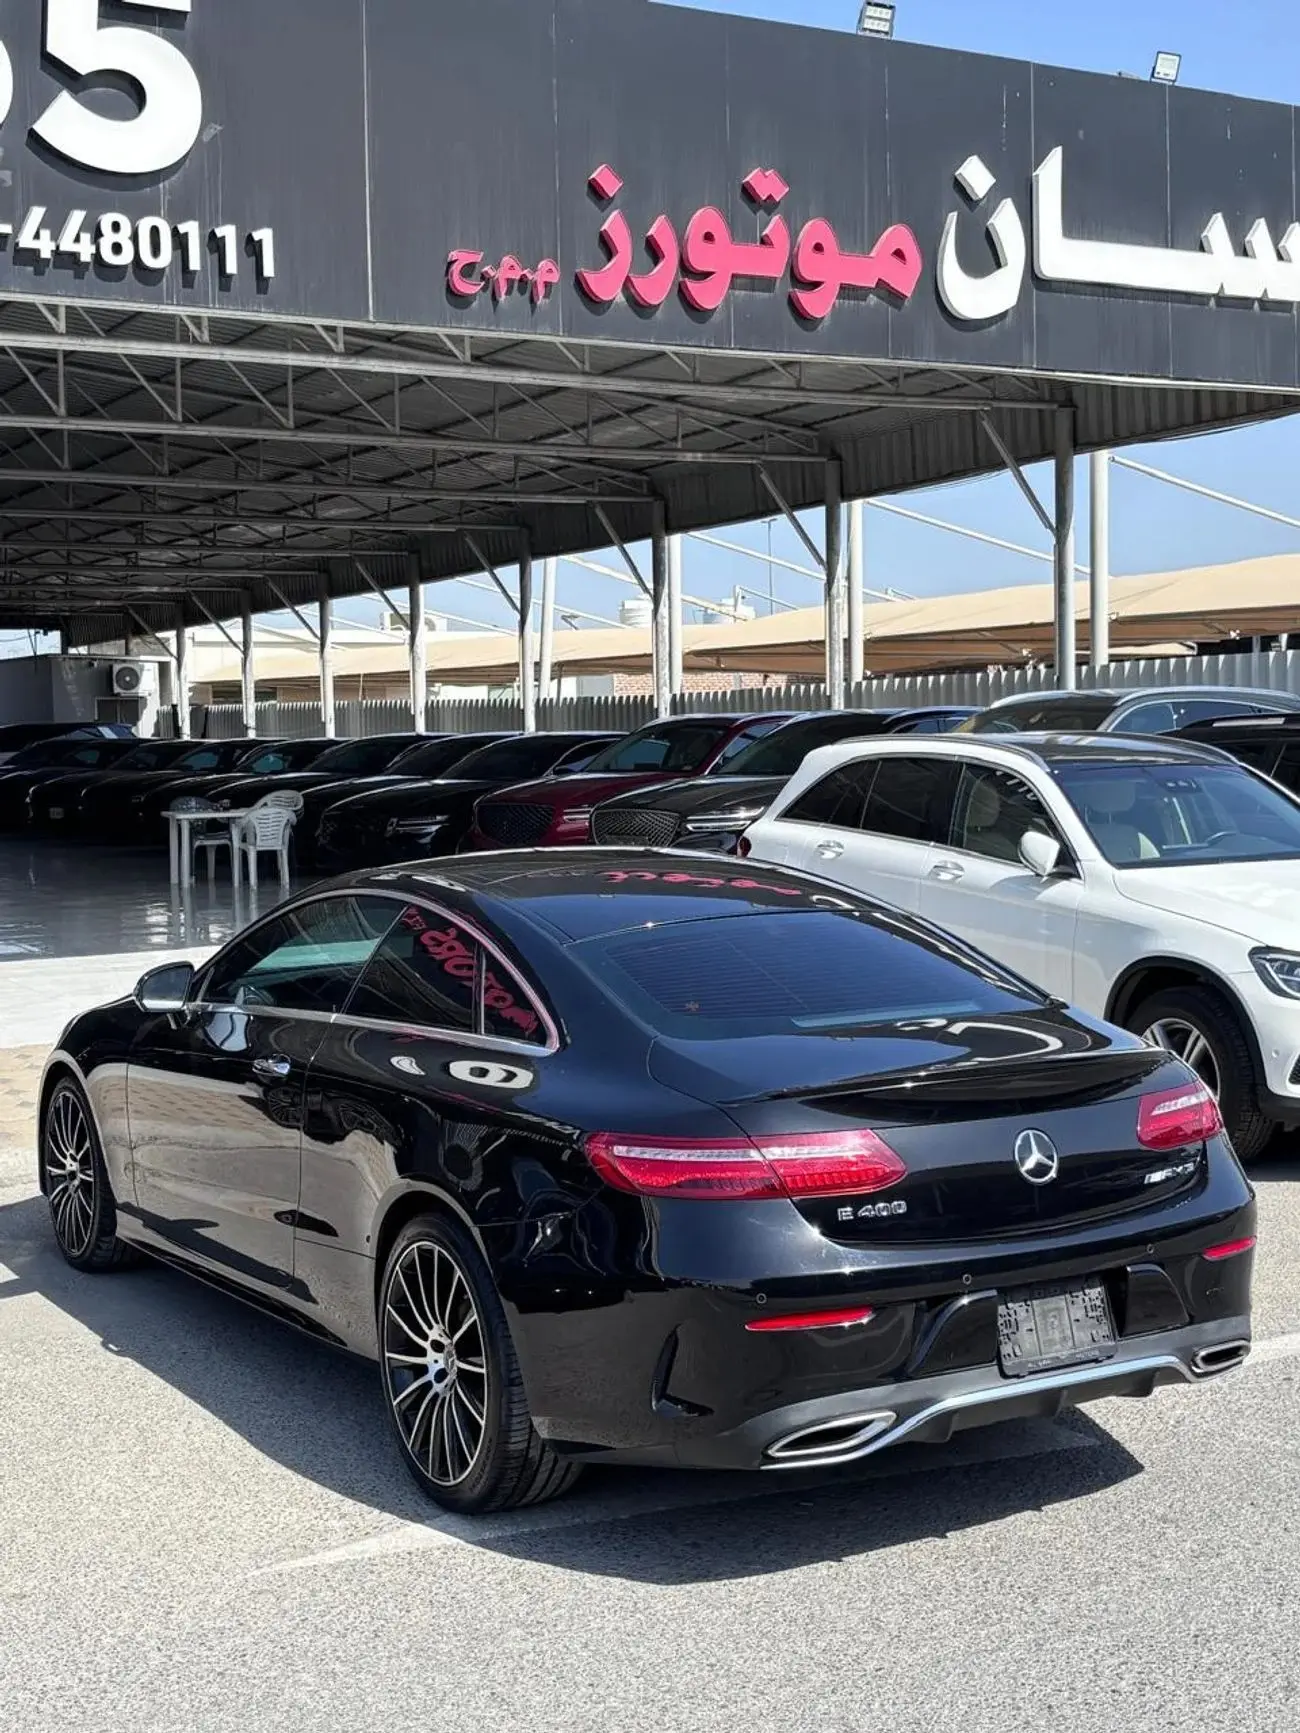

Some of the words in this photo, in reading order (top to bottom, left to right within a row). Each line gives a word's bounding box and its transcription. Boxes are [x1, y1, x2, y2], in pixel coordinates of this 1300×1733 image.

[0, 0, 202, 173] 5
[573, 163, 922, 319] موتورز
[837, 1206, 854, 1221] E
[857, 1200, 907, 1217] 400
